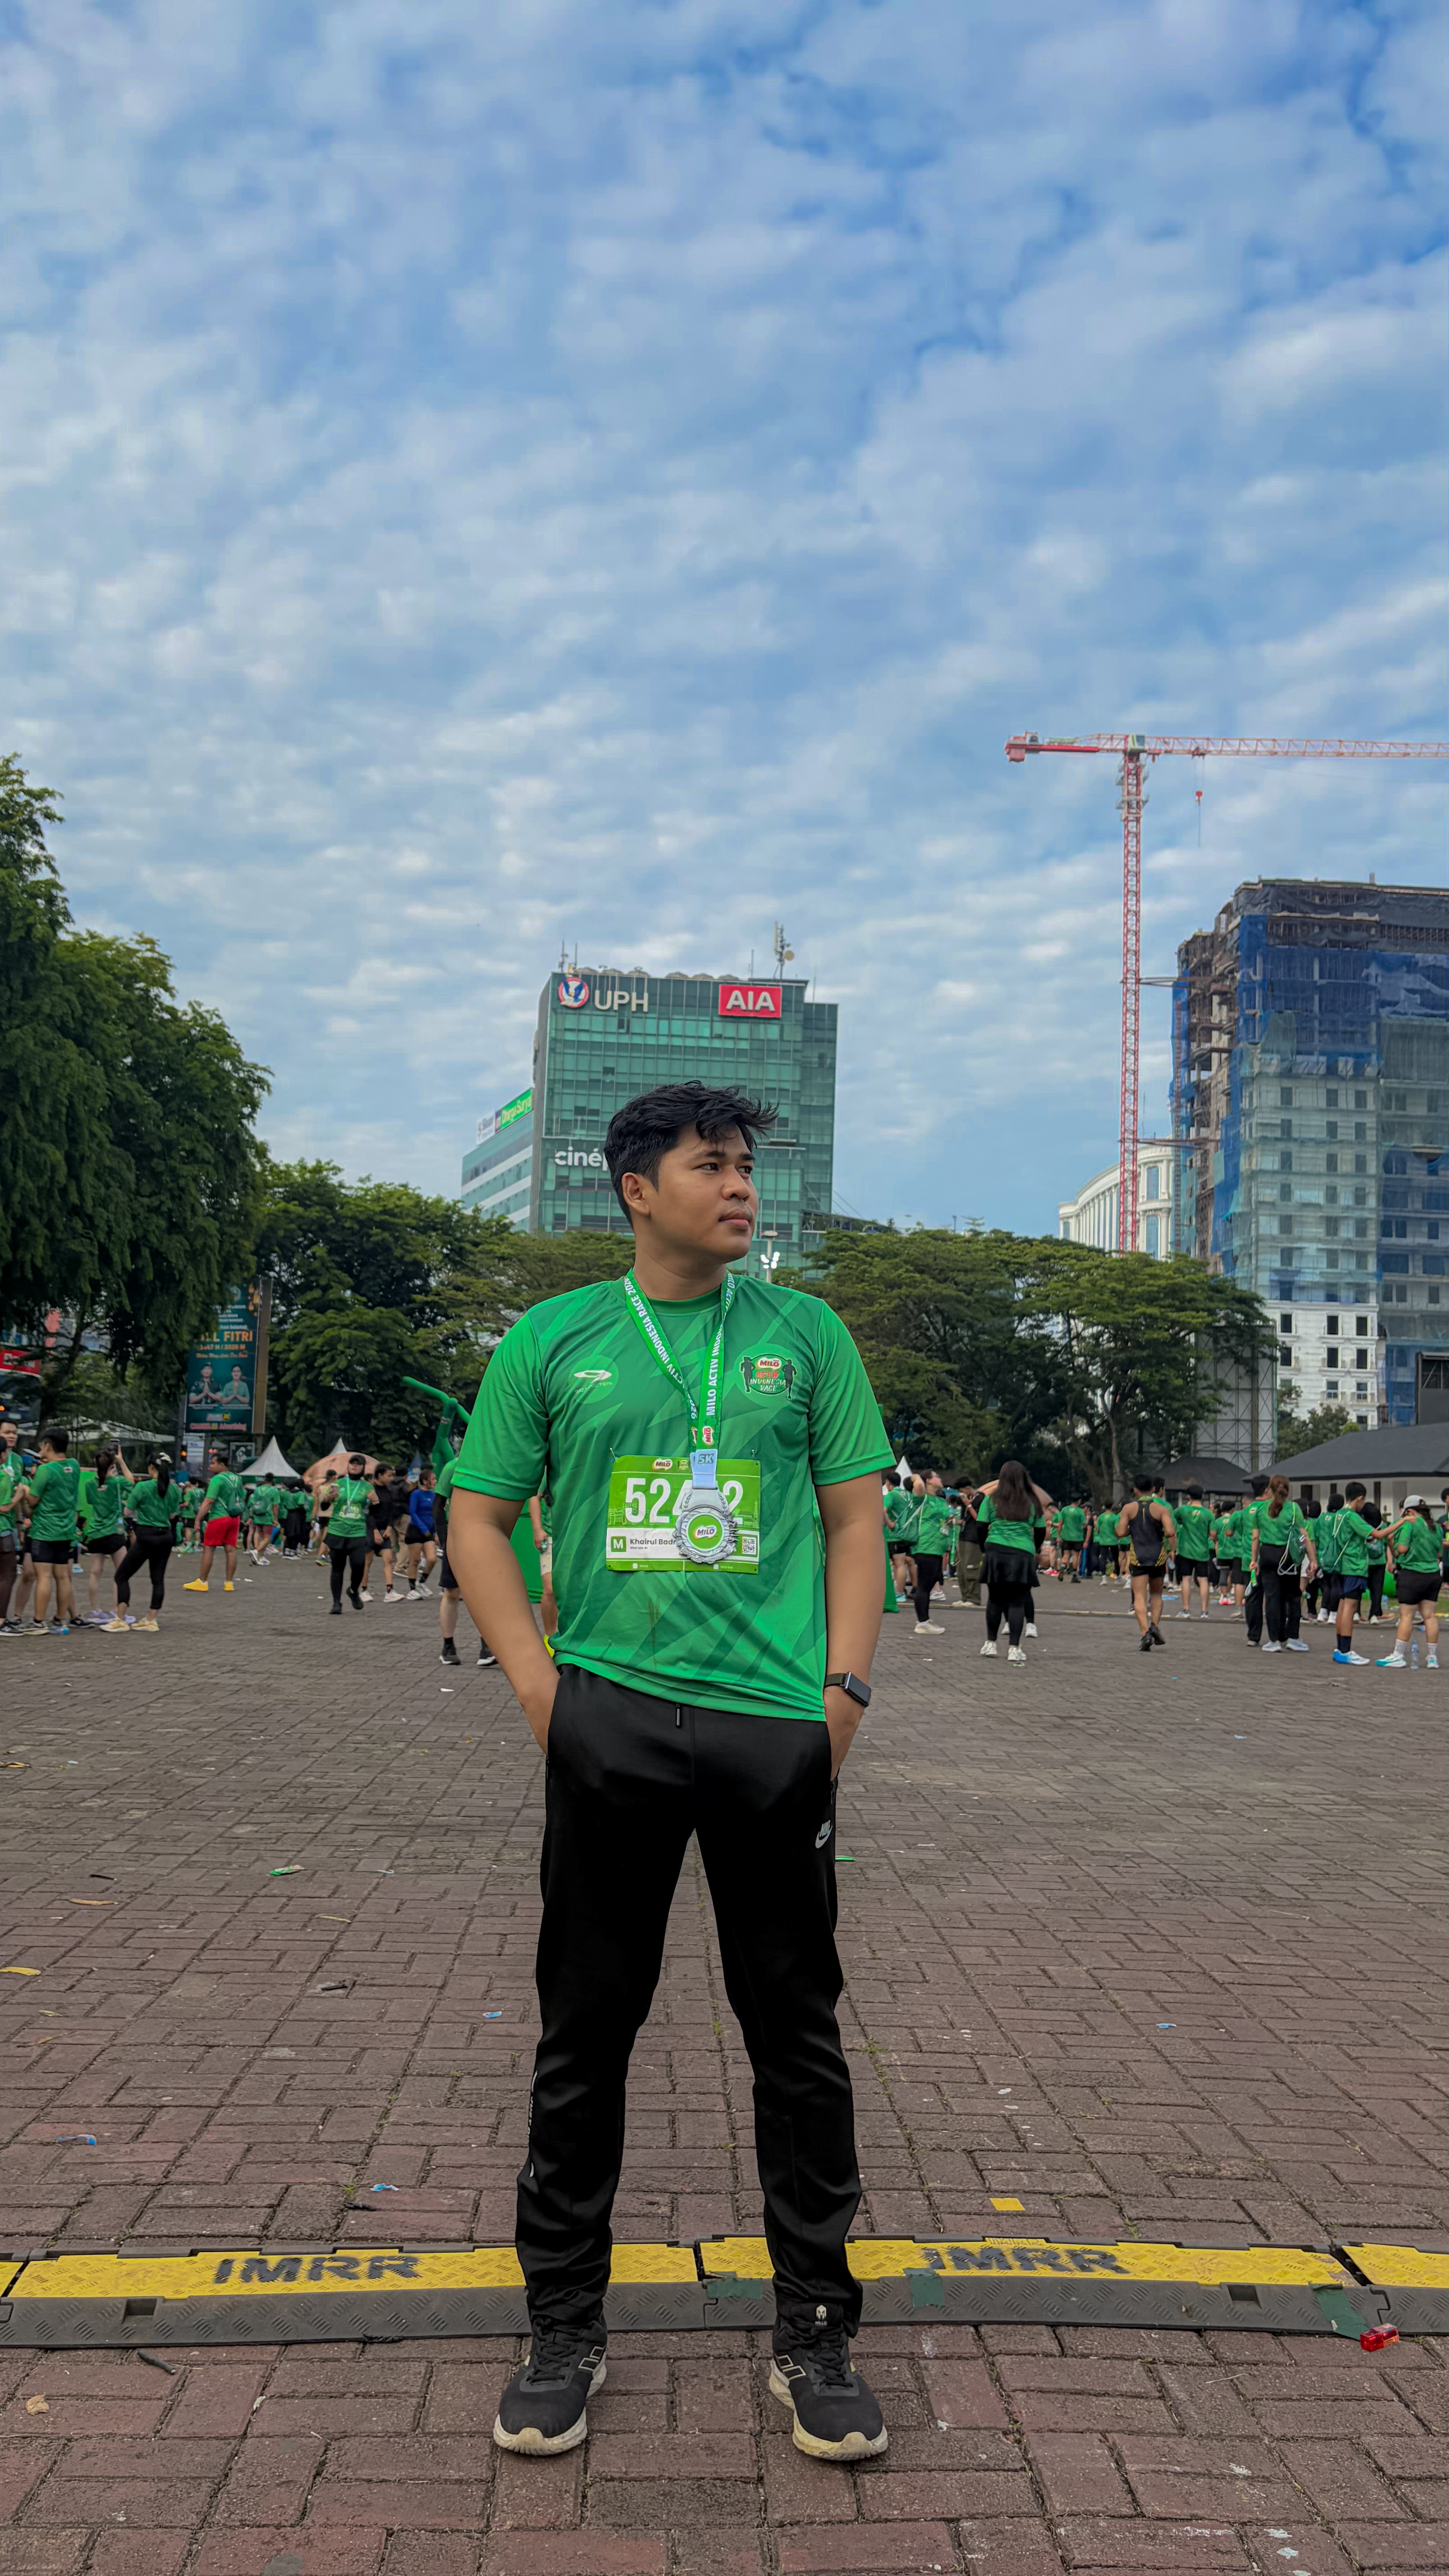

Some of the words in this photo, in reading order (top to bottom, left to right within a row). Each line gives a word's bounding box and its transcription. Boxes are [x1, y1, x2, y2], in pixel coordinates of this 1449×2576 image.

[594, 989, 649, 1012] UPH
[726, 989, 775, 1012] AIA
[630, 1294, 648, 1317] RACE
[224, 1331, 253, 1342] FITRI
[642, 1316, 670, 1364] INDONESIA
[667, 1363, 685, 1386] CTIV
[708, 1358, 719, 1386] ACTIV
[759, 1359, 780, 1367] MILO
[706, 1389, 717, 1416] MILO
[699, 1454, 714, 1464] 5K
[626, 1477, 743, 1525] 5242
[613, 1538, 624, 1549] M
[212, 2257, 420, 2284] IMRR
[924, 2248, 1130, 2274] IMRR
